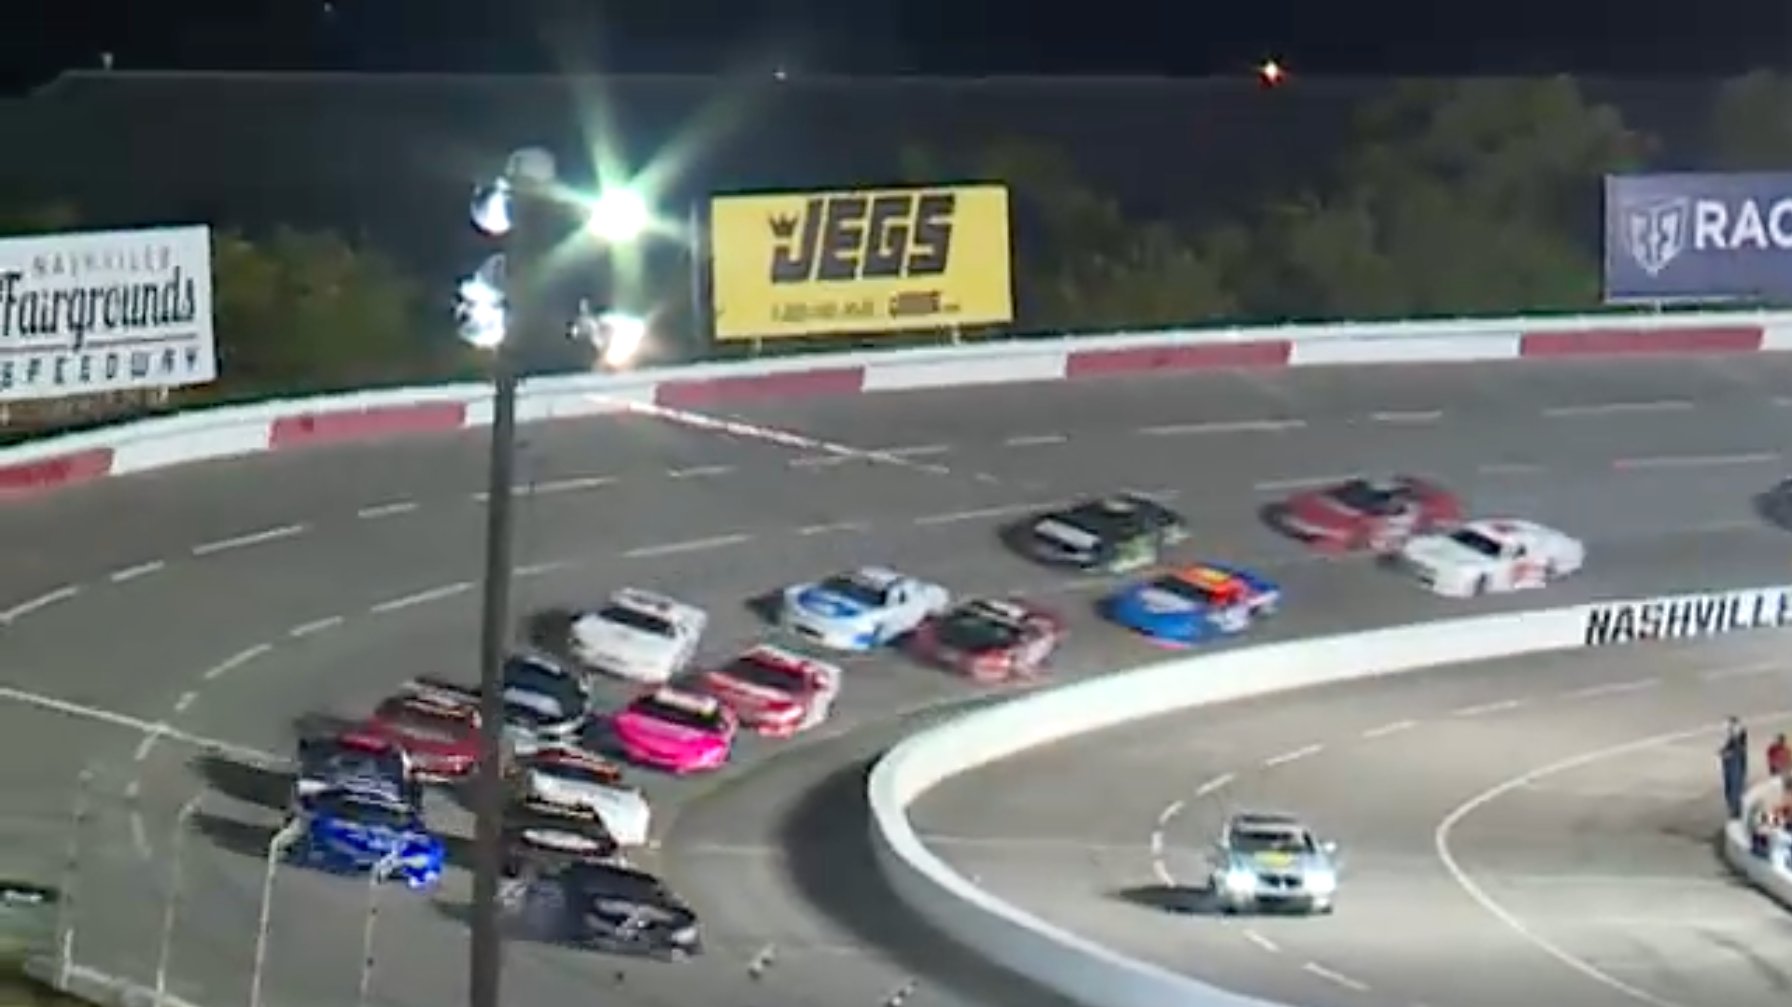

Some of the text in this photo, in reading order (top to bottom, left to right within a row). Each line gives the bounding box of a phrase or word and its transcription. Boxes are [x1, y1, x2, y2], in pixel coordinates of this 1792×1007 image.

[770, 194, 954, 283] JEGS
[1, 266, 195, 353] Fairgrounds
[1, 349, 199, 388] SPEEDWAY
